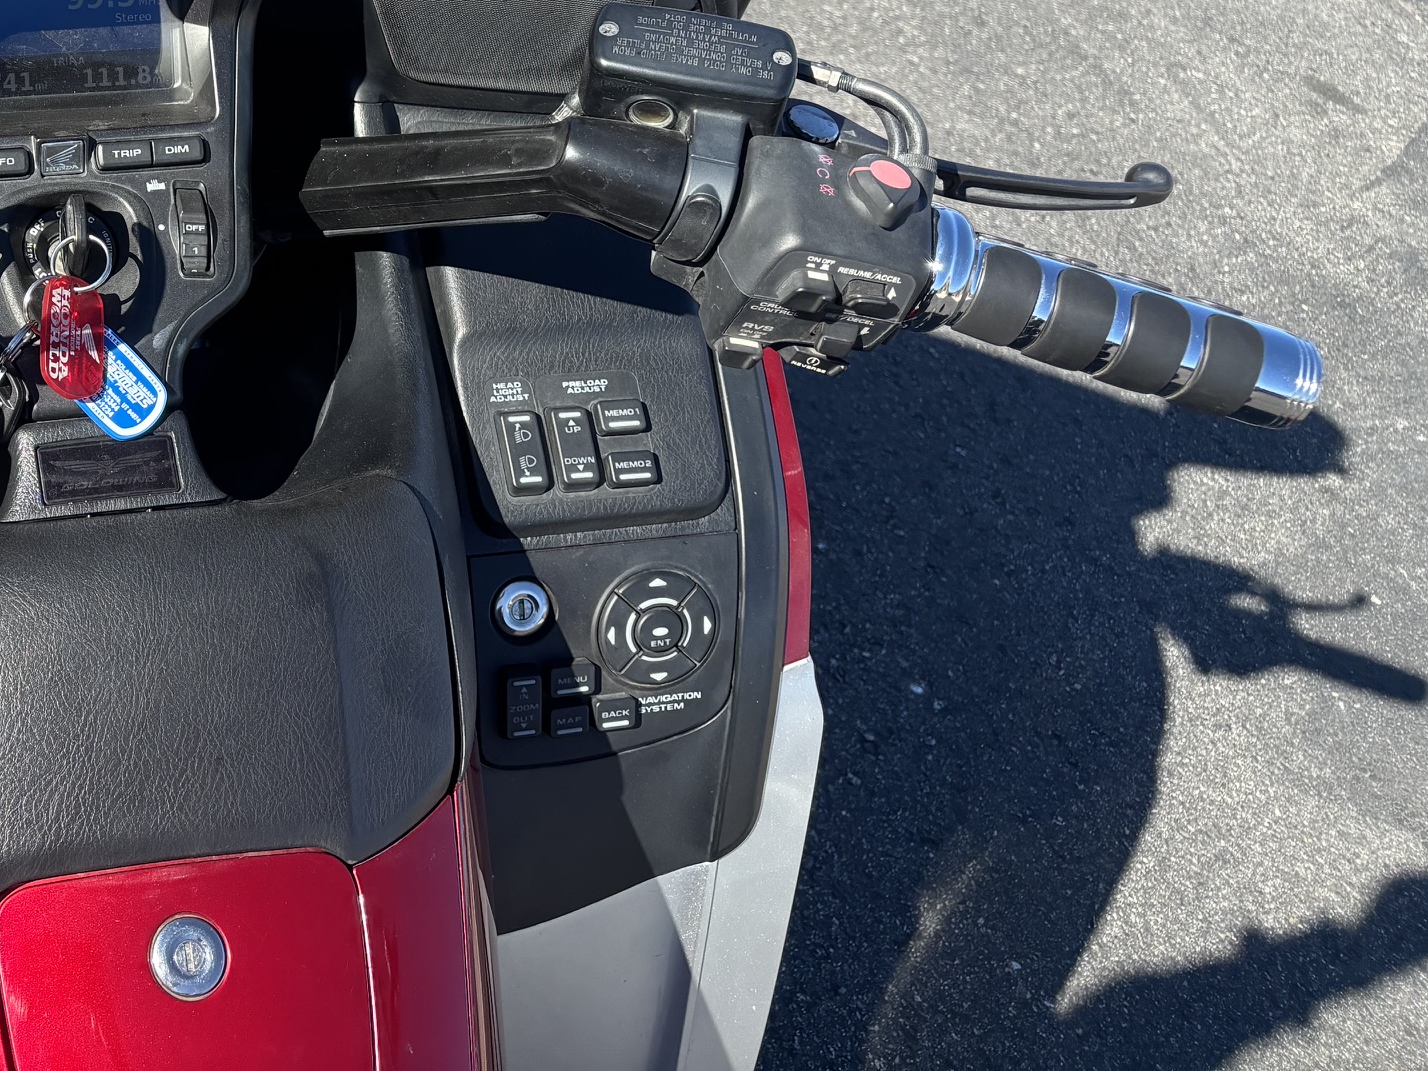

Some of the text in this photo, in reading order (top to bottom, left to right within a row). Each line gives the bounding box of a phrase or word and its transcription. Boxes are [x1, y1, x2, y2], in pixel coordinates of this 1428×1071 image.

[115, 12, 152, 23] Stereo
[83, 65, 152, 89] 111.8
[112, 149, 142, 159] TRIP
[165, 144, 190, 154] DIM
[30, 218, 45, 236] OFF
[185, 224, 206, 232] OFF
[837, 267, 901, 283] RESUME/ACCEL
[751, 306, 798, 316] CONTROL
[742, 322, 774, 331] RVS
[49, 286, 61, 379] WORLD
[58, 287, 70, 381] HONDA
[791, 360, 826, 374] REVERSE
[492, 381, 522, 389] HEAD
[562, 379, 608, 388] PRELOAD
[136, 380, 157, 402] YAMAHA
[567, 386, 606, 394] ADJUST
[489, 394, 530, 403] ADJUST
[564, 426, 582, 434] UP
[564, 456, 595, 465] DOWN
[651, 638, 672, 648] ENT
[558, 675, 588, 685] MENU
[638, 691, 702, 704] NAVIGATION
[510, 704, 539, 713] ZOOM
[639, 702, 684, 713] SYSTEM
[602, 709, 630, 719] BACK
[513, 715, 535, 724] OUT
[556, 716, 582, 726] MAP
